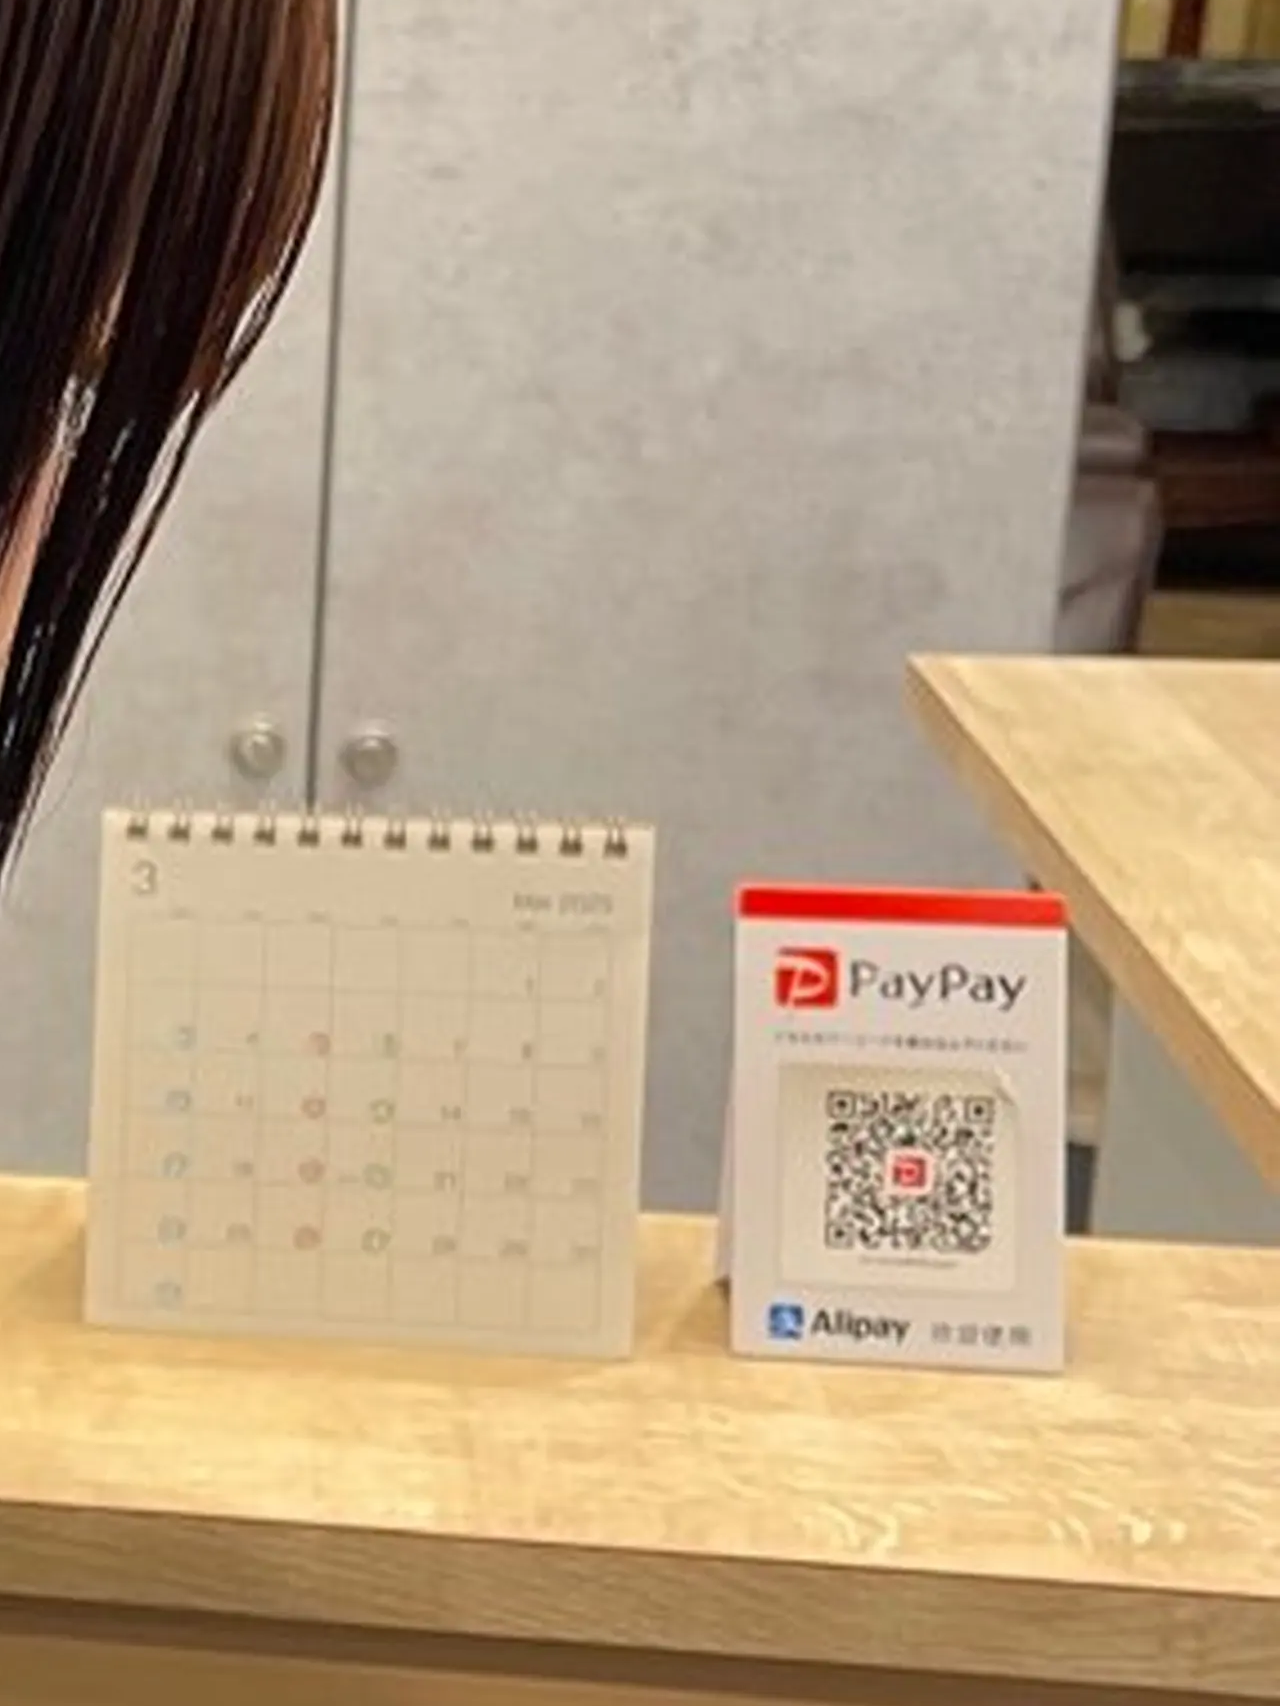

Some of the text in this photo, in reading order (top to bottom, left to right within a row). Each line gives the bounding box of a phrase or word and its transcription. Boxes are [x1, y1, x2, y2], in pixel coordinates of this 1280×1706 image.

[130, 858, 159, 898] 3
[849, 957, 1028, 1013] PayPay
[810, 1307, 912, 1348] Alipay
